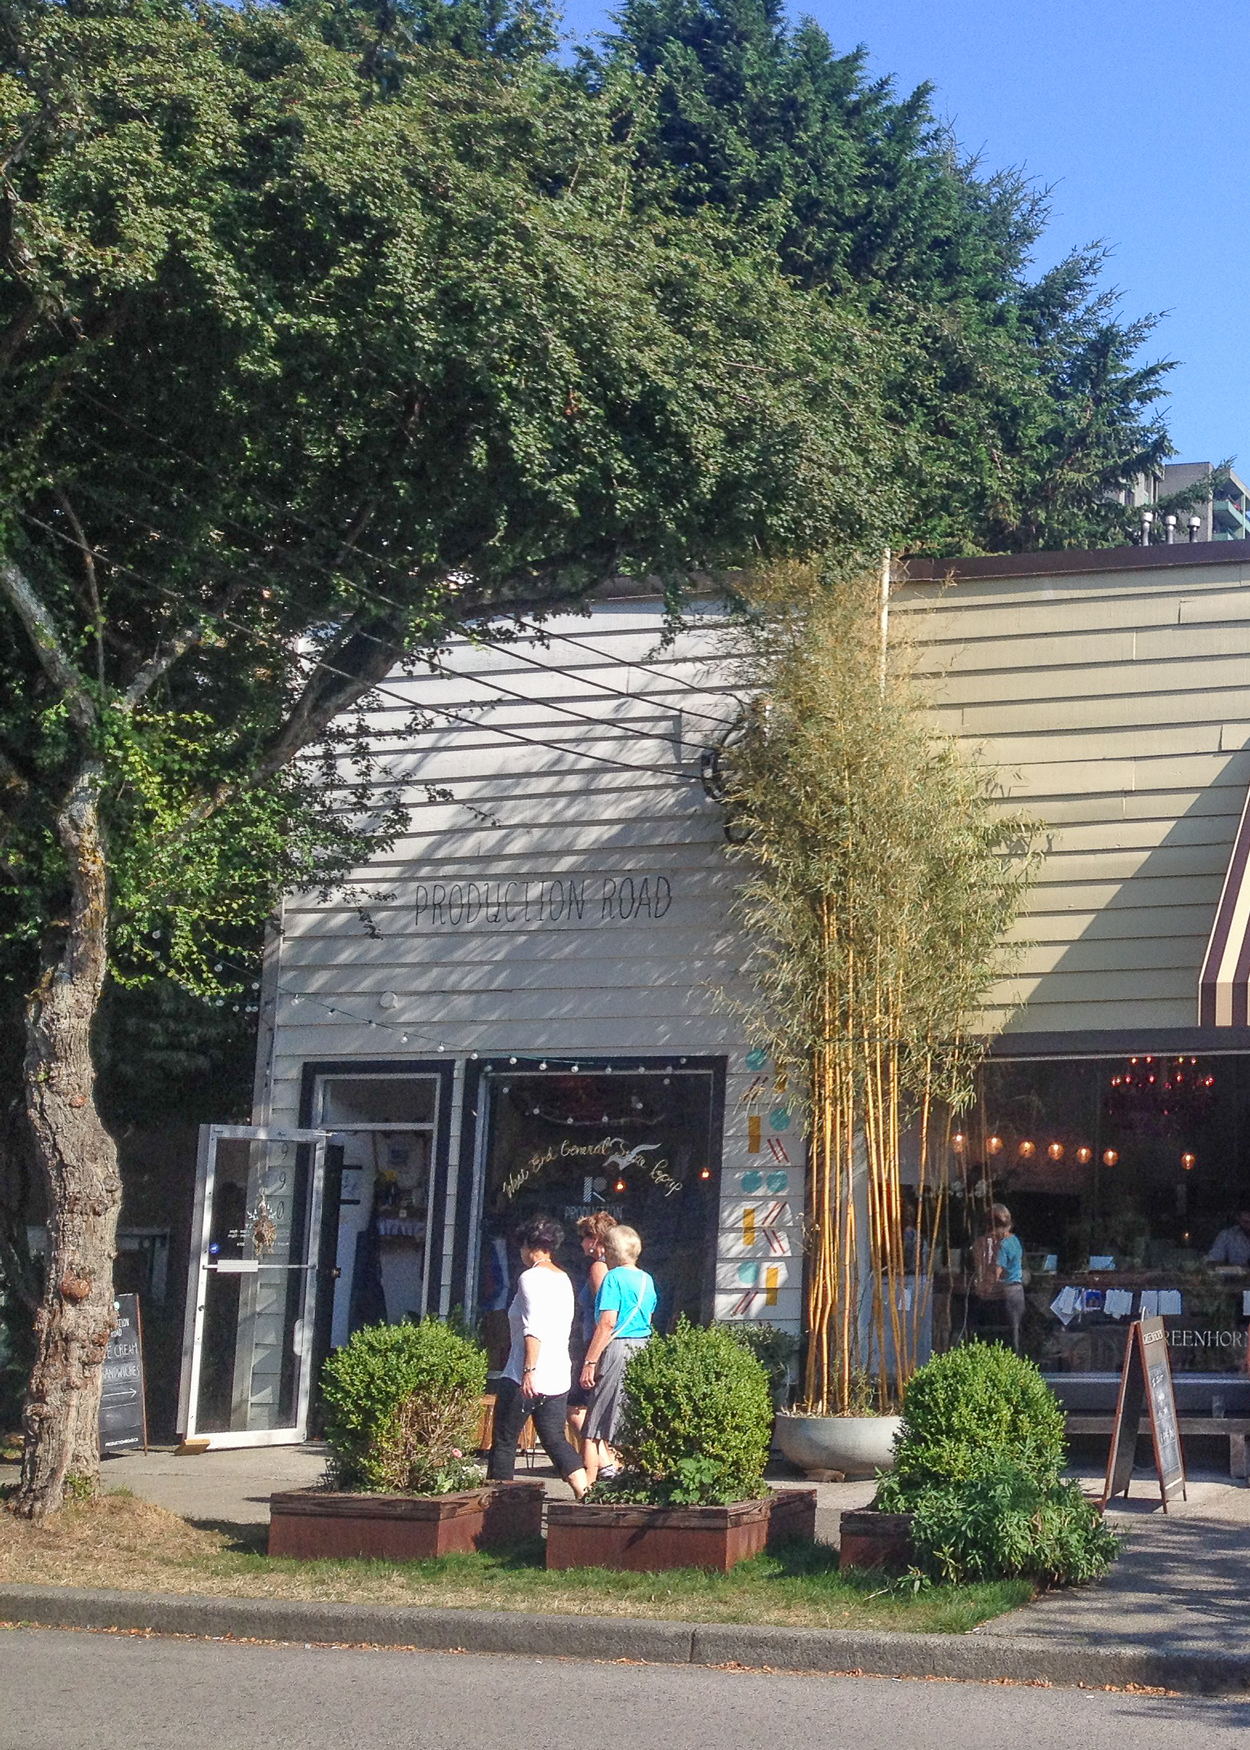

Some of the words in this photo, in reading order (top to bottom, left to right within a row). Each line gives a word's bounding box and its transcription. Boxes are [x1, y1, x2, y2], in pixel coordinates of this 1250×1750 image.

[415, 879, 586, 926] PRODUCTION
[601, 876, 673, 920] ROAD
[561, 1137, 611, 1157] General
[615, 1142, 648, 1168] Sre
[1165, 1330, 1248, 1347] REENHOR
